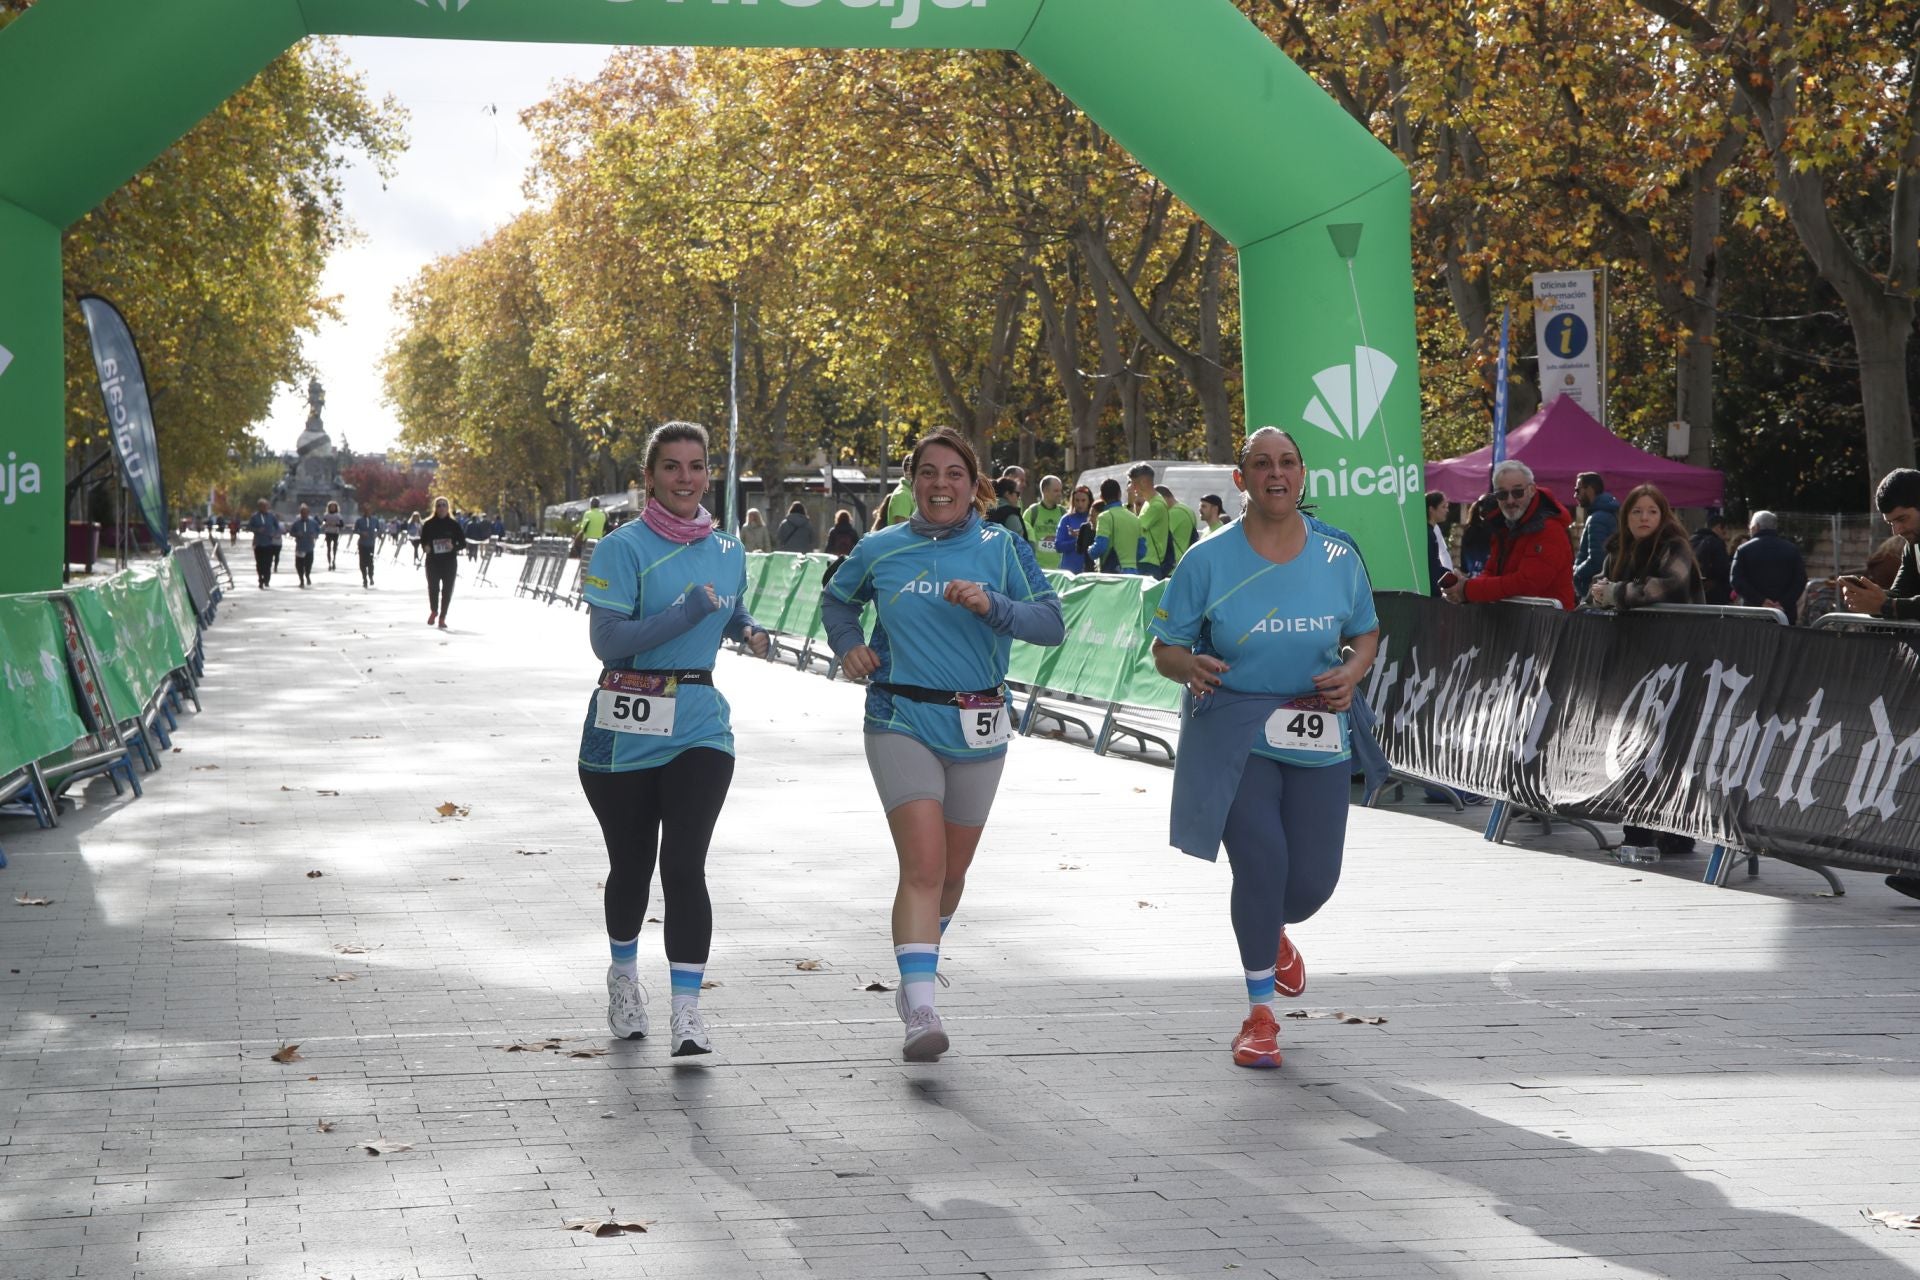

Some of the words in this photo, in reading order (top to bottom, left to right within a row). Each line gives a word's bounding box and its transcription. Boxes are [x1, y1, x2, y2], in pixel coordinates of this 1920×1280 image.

[1540, 280, 1566, 289] Oficina
[0, 451, 41, 504] ja
[1309, 454, 1419, 505] nicaja
[899, 580, 989, 595] ADIT
[1250, 615, 1335, 633] ADIENT
[612, 695, 650, 722] 50
[1286, 713, 1324, 739] 49
[1681, 658, 1842, 813] Norte
